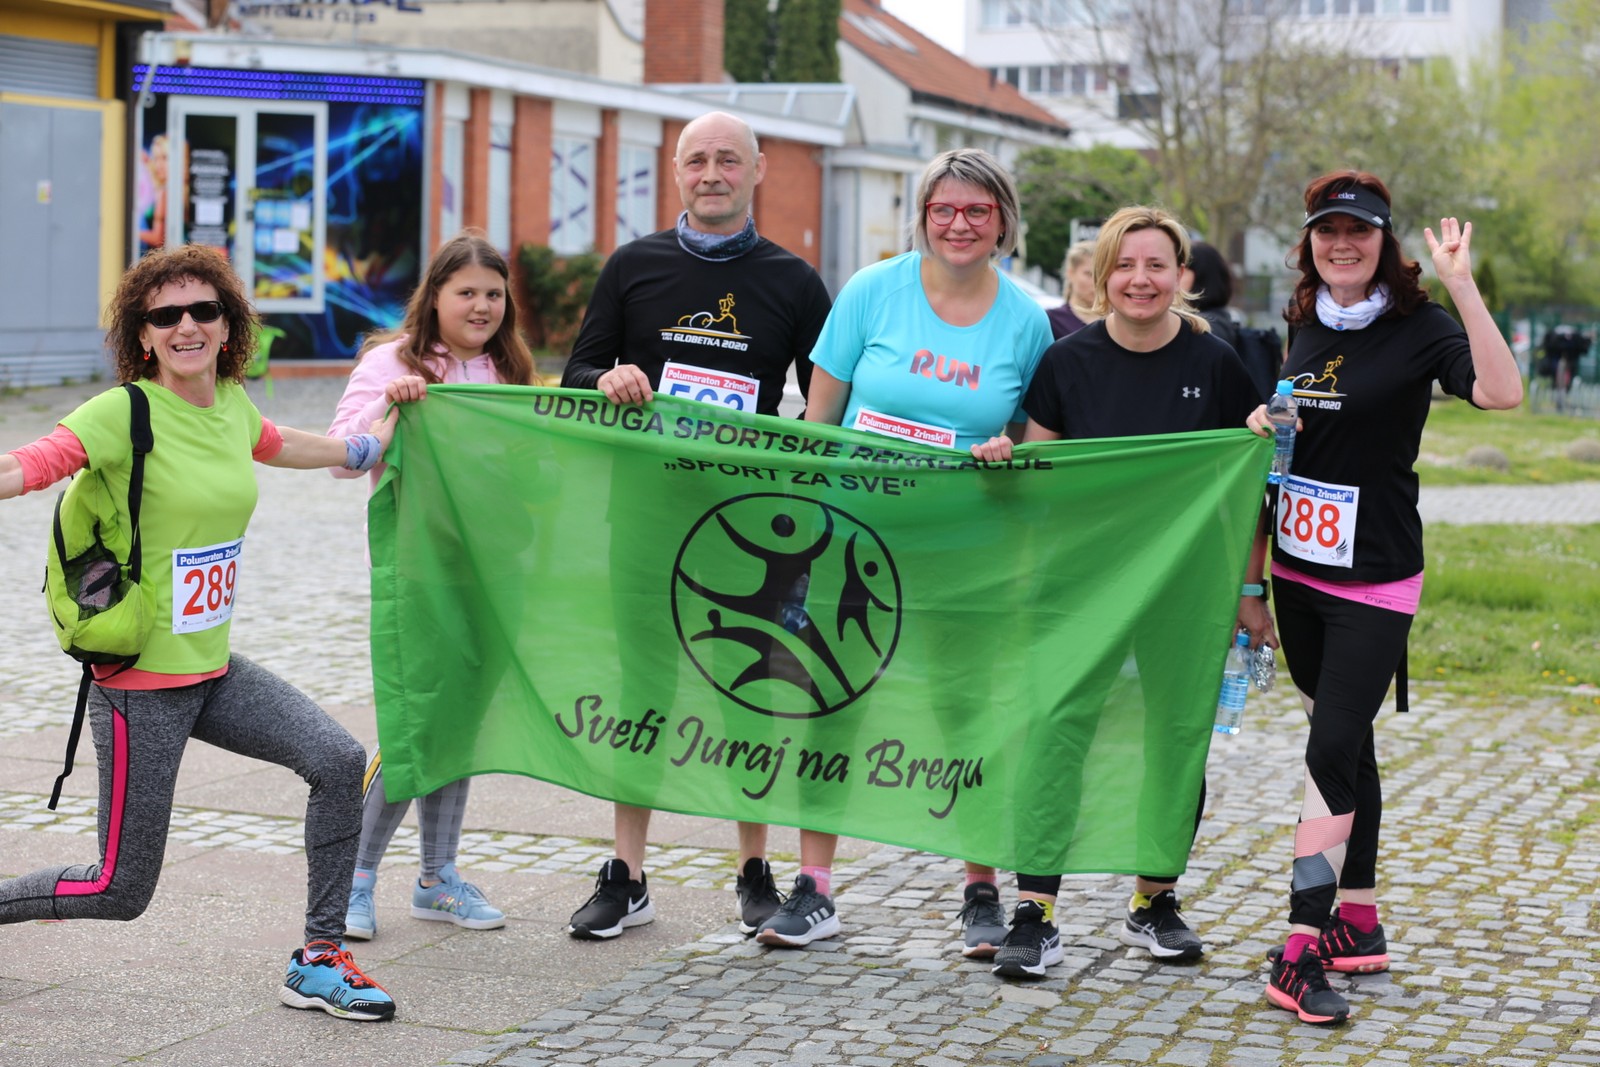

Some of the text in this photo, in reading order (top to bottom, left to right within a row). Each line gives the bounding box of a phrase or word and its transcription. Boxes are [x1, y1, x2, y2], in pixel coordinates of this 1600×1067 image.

[673, 333, 748, 352] GLOBETKA 2020
[667, 369, 721, 387] Polumaraton
[910, 349, 981, 391] RUN
[1318, 399, 1342, 411] 2020
[533, 394, 664, 435] UDRUGA
[673, 415, 844, 459] SPORTSKE
[861, 415, 911, 435] Polumaraton
[790, 469, 832, 488] ZA
[1280, 491, 1340, 548] 288
[180, 552, 224, 566] Polumaraton
[182, 560, 236, 616] 289
[554, 695, 984, 819] Sveti Juraj na Bregu
